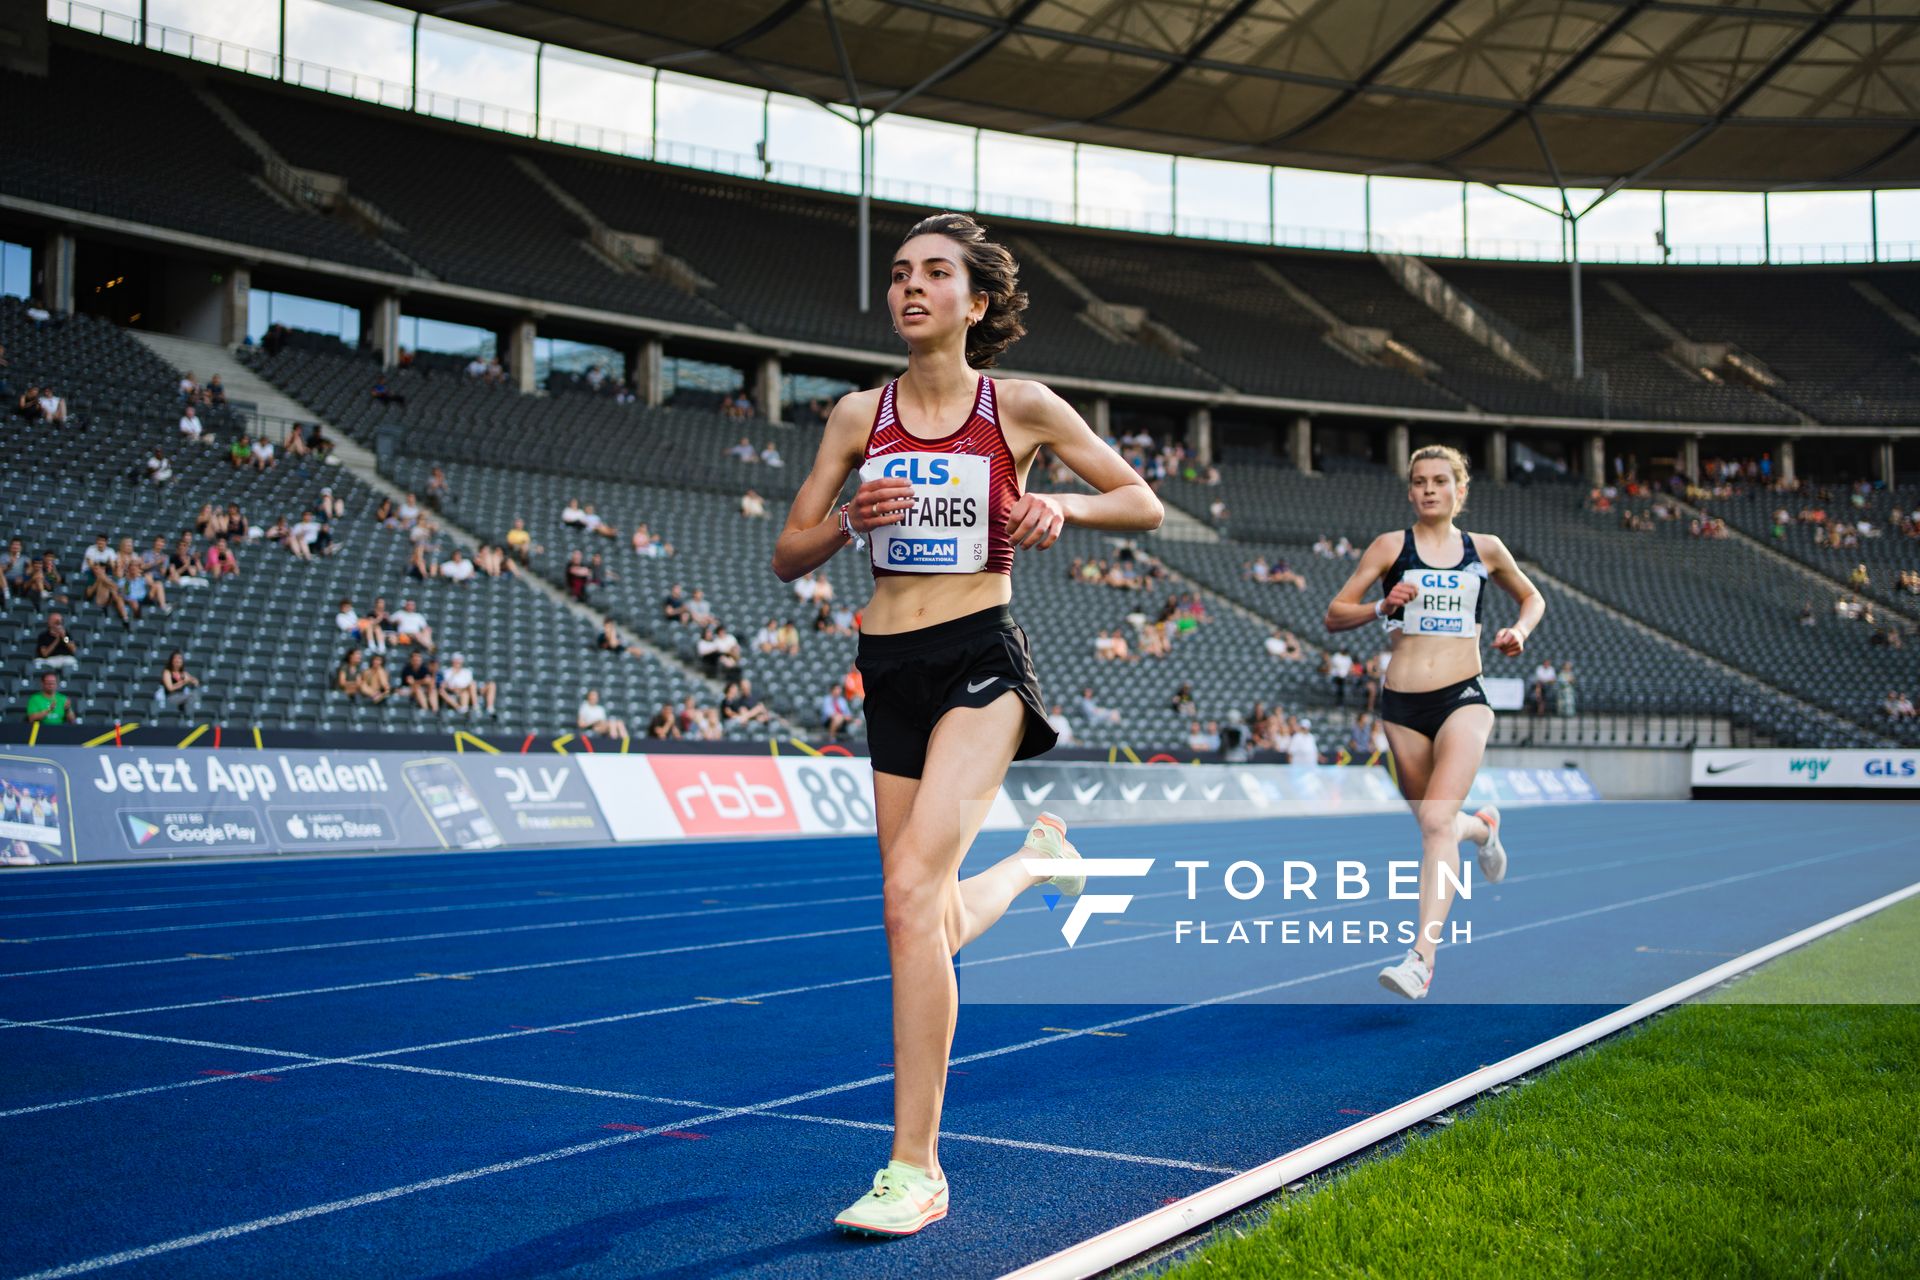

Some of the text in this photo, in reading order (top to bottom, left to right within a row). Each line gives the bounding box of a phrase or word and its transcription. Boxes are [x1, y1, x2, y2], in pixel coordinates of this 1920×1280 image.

[881, 497, 977, 527] NFARES
[913, 543, 955, 556] PLAN
[973, 543, 983, 561] 526
[1423, 594, 1461, 611] REH
[1437, 619, 1461, 627] PLAN
[94, 755, 388, 801] Jetzt App laden!
[1789, 757, 1831, 780] wgv
[1864, 758, 1917, 777] GLS
[495, 766, 570, 801] DLV
[676, 771, 785, 821] rbb
[797, 766, 876, 830] 88
[166, 822, 255, 845] Google Play
[313, 820, 382, 841] App Store
